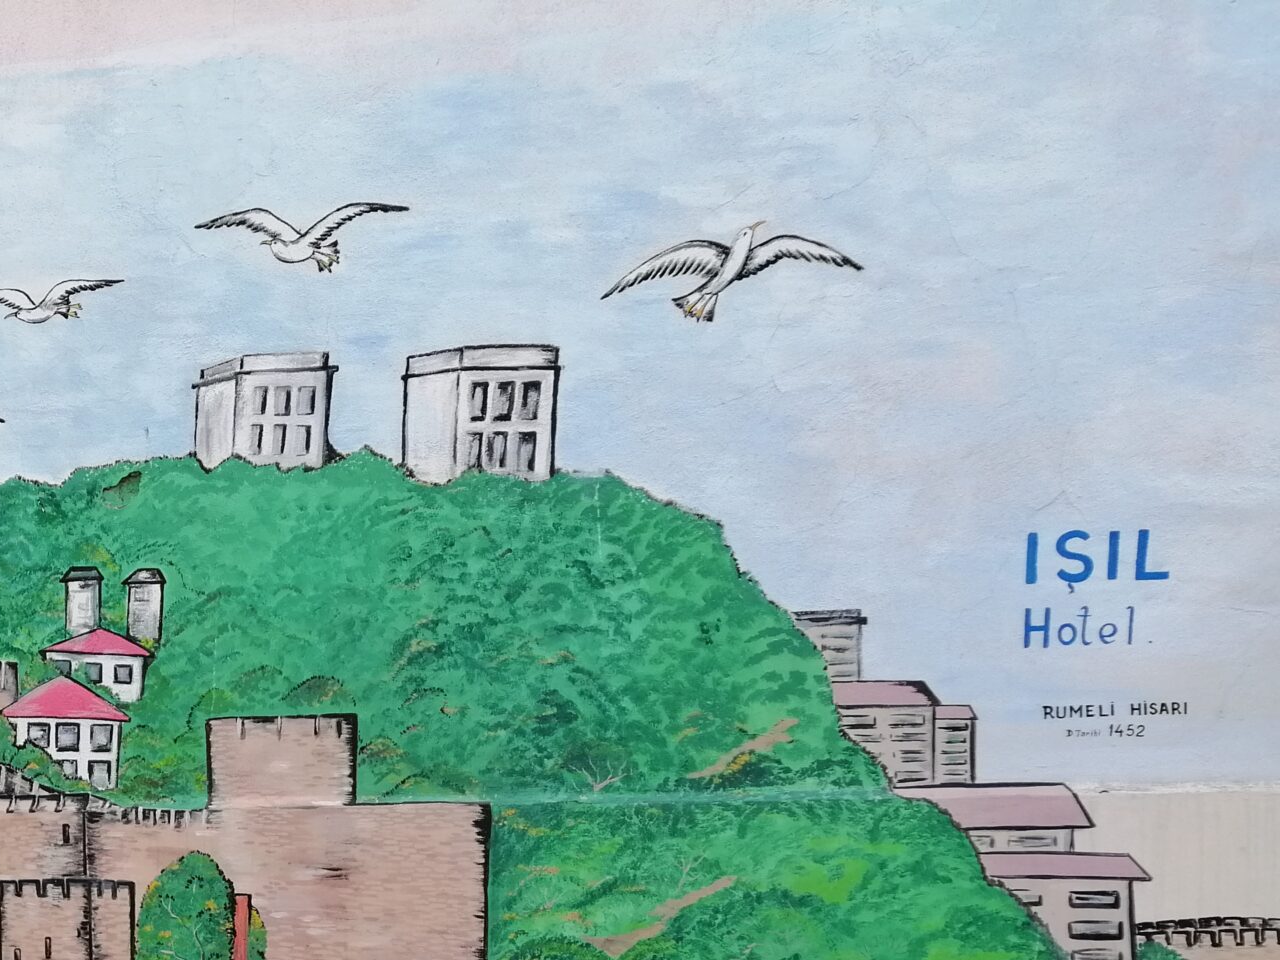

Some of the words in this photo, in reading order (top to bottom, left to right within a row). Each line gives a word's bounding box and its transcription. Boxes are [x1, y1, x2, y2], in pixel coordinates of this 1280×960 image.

[1025, 529, 1170, 594] IŞIL
[1042, 701, 1115, 720] RUMELİ
[1130, 700, 1188, 717] HİSARI
[1109, 723, 1145, 737] 1452
